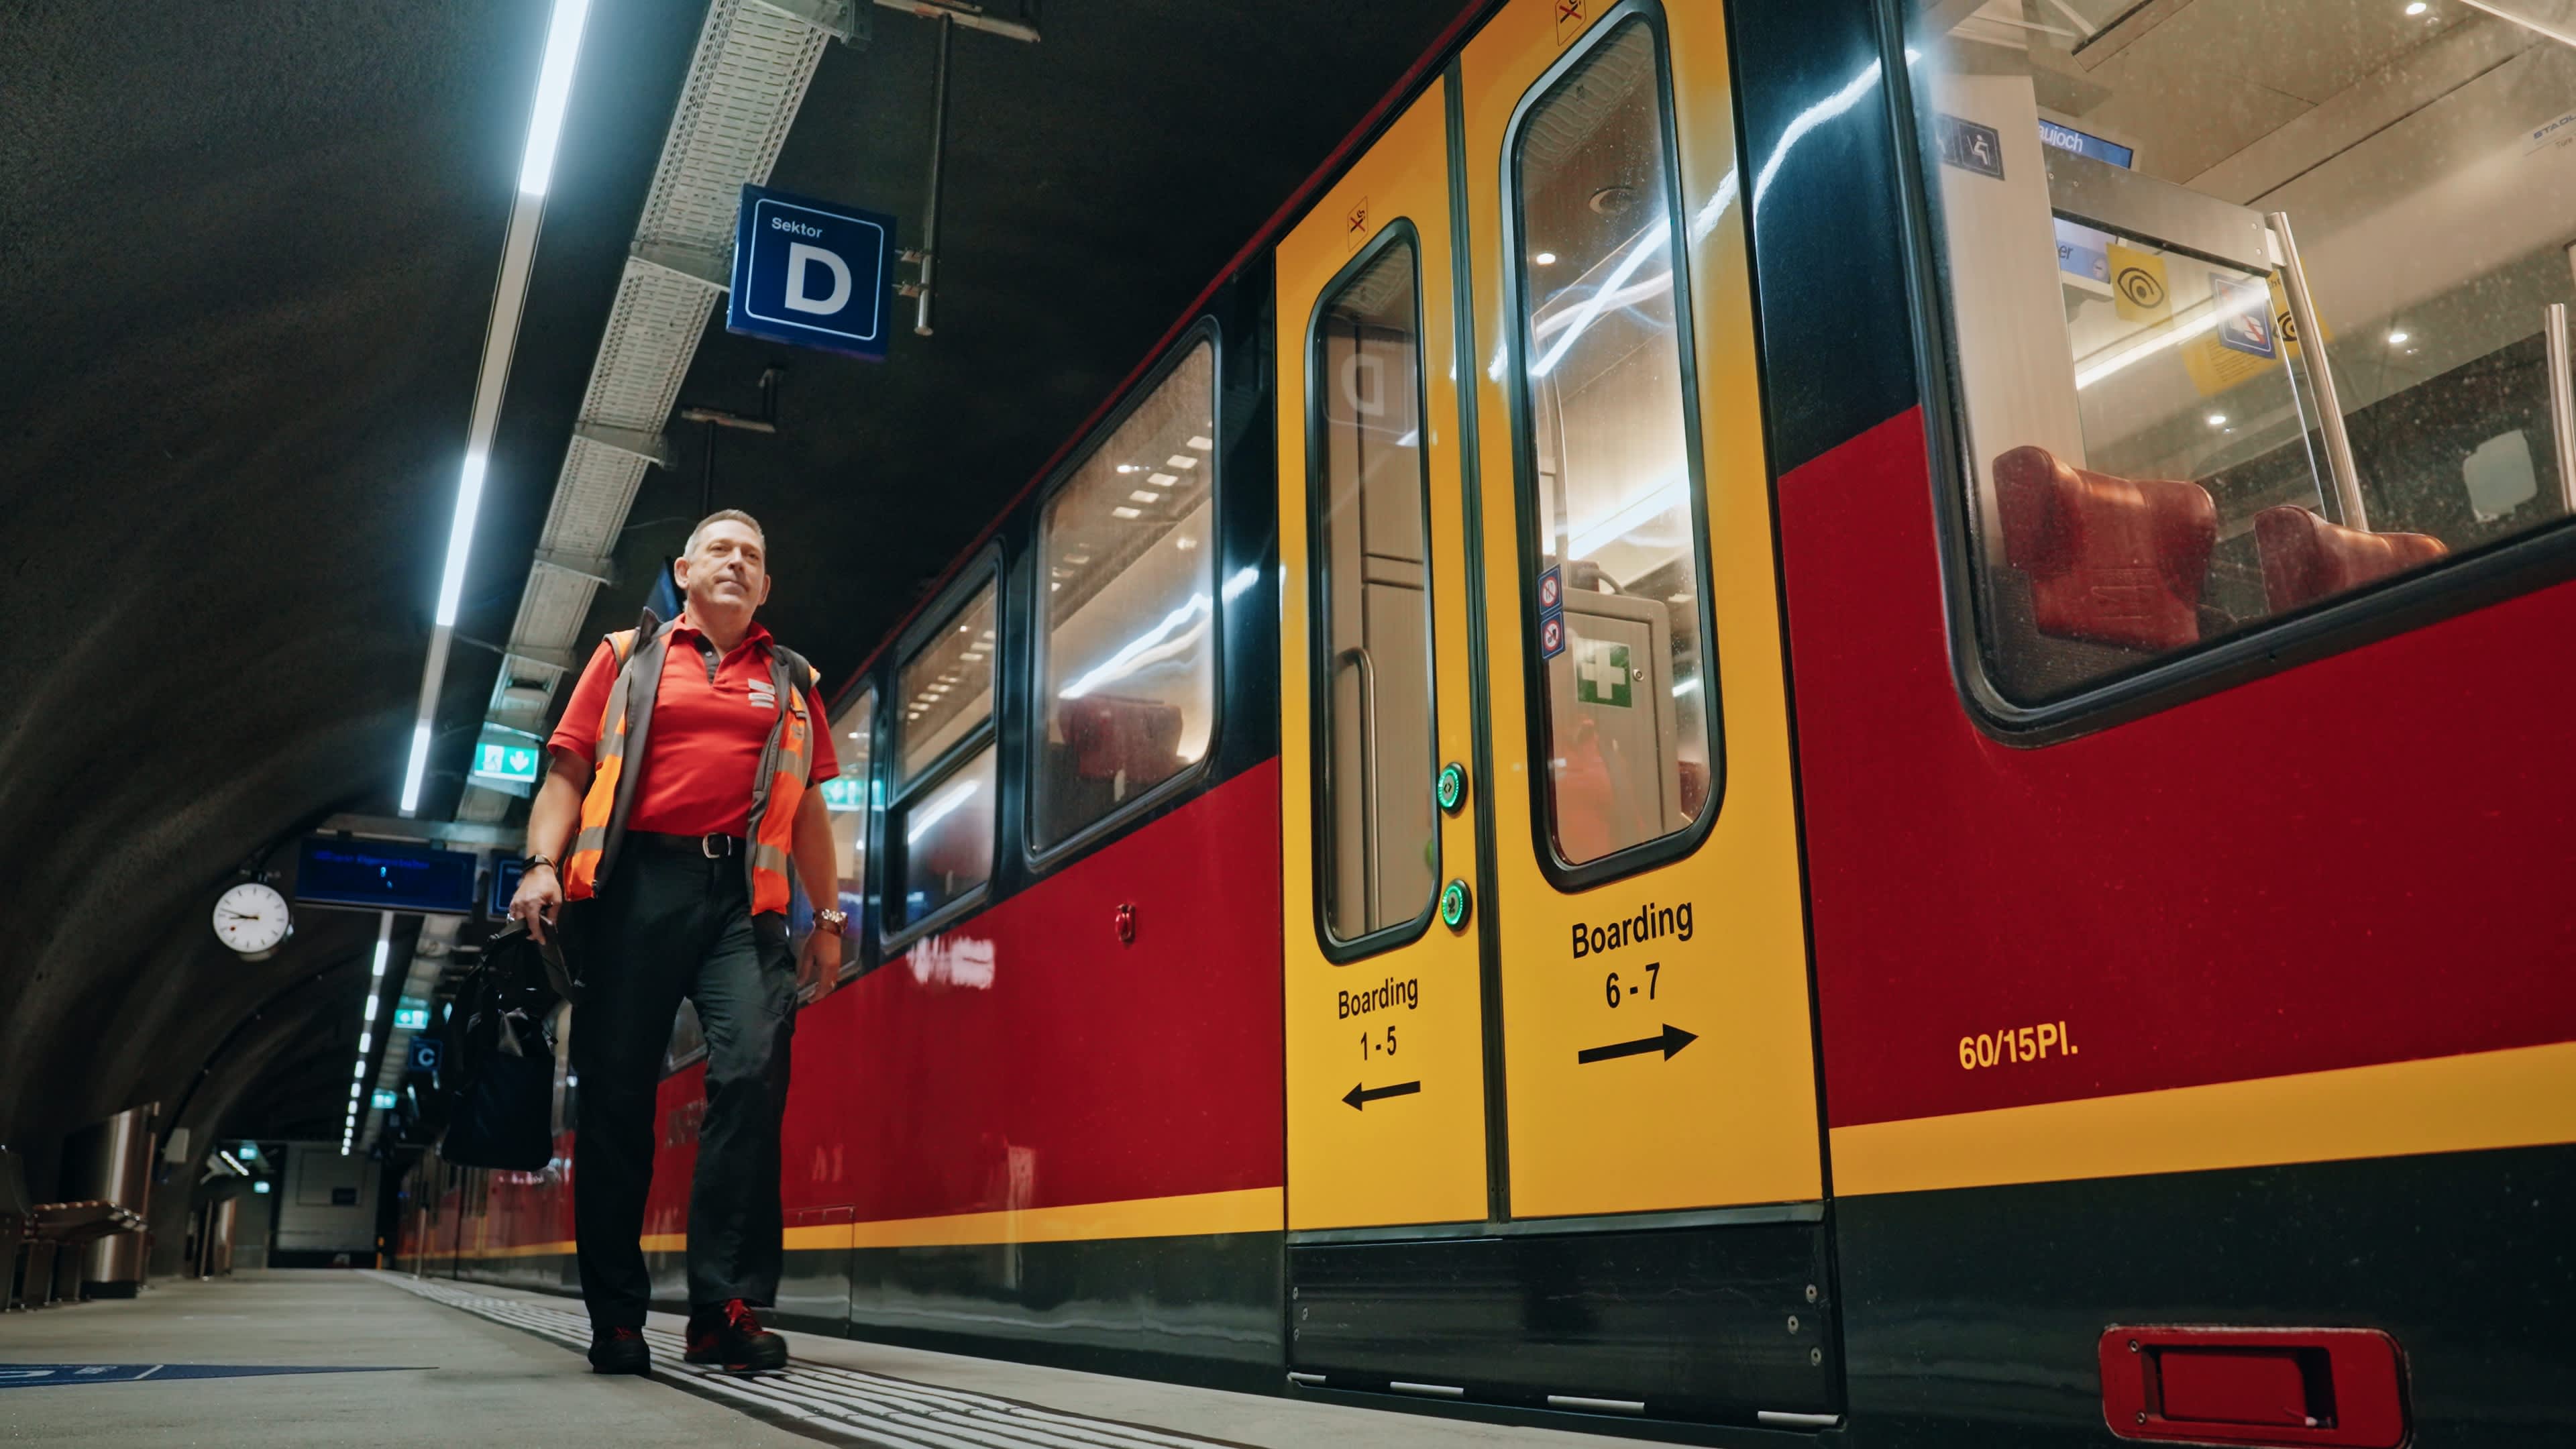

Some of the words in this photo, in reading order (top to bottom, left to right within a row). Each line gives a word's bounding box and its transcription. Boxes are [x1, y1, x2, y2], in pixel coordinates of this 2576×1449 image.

[771, 217, 823, 238] Sektor
[784, 241, 852, 315] D
[1572, 902, 1693, 959] Boarding
[1338, 977, 1418, 1020] Boarding
[1606, 972, 1621, 1008] 6
[1646, 961, 1660, 1000] 7
[417, 1047, 435, 1067] C
[1360, 1031, 1368, 1061] 1
[1387, 1025, 1397, 1056] 5
